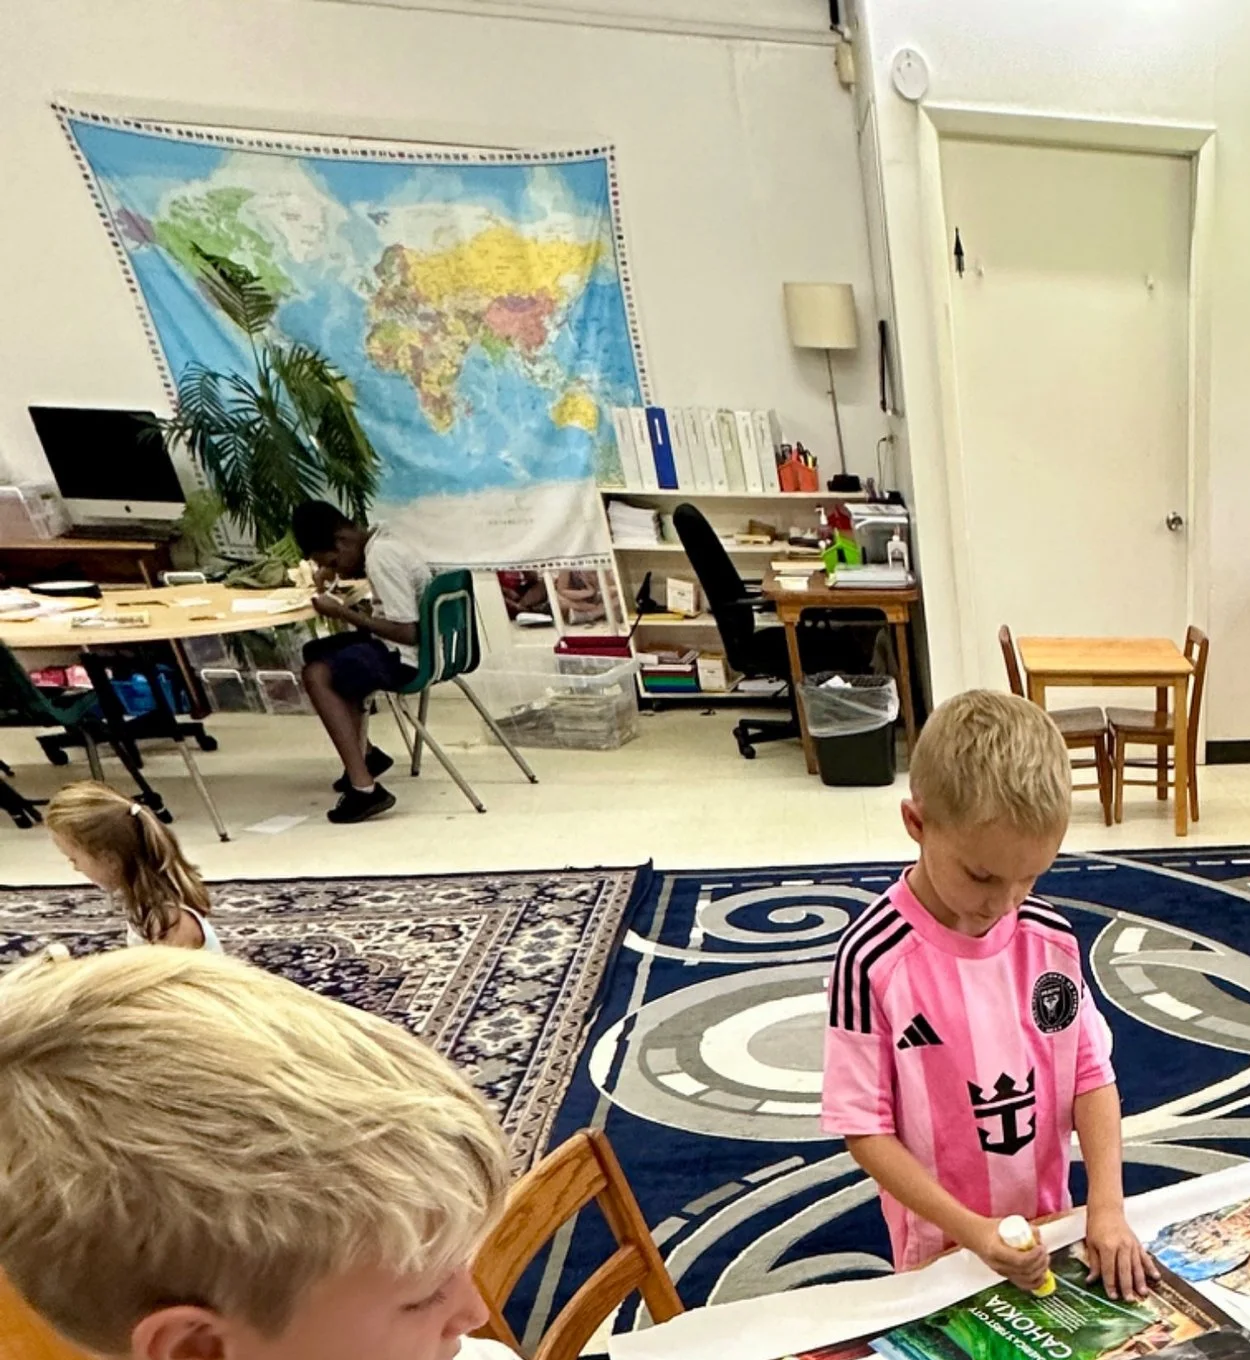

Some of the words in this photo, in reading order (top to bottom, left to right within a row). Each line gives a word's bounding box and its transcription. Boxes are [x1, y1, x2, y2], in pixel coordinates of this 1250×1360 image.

[967, 1303, 991, 1324] CITY
[985, 1294, 1072, 1359] CAHOKIA
[987, 1318, 1011, 1339] FIRST
